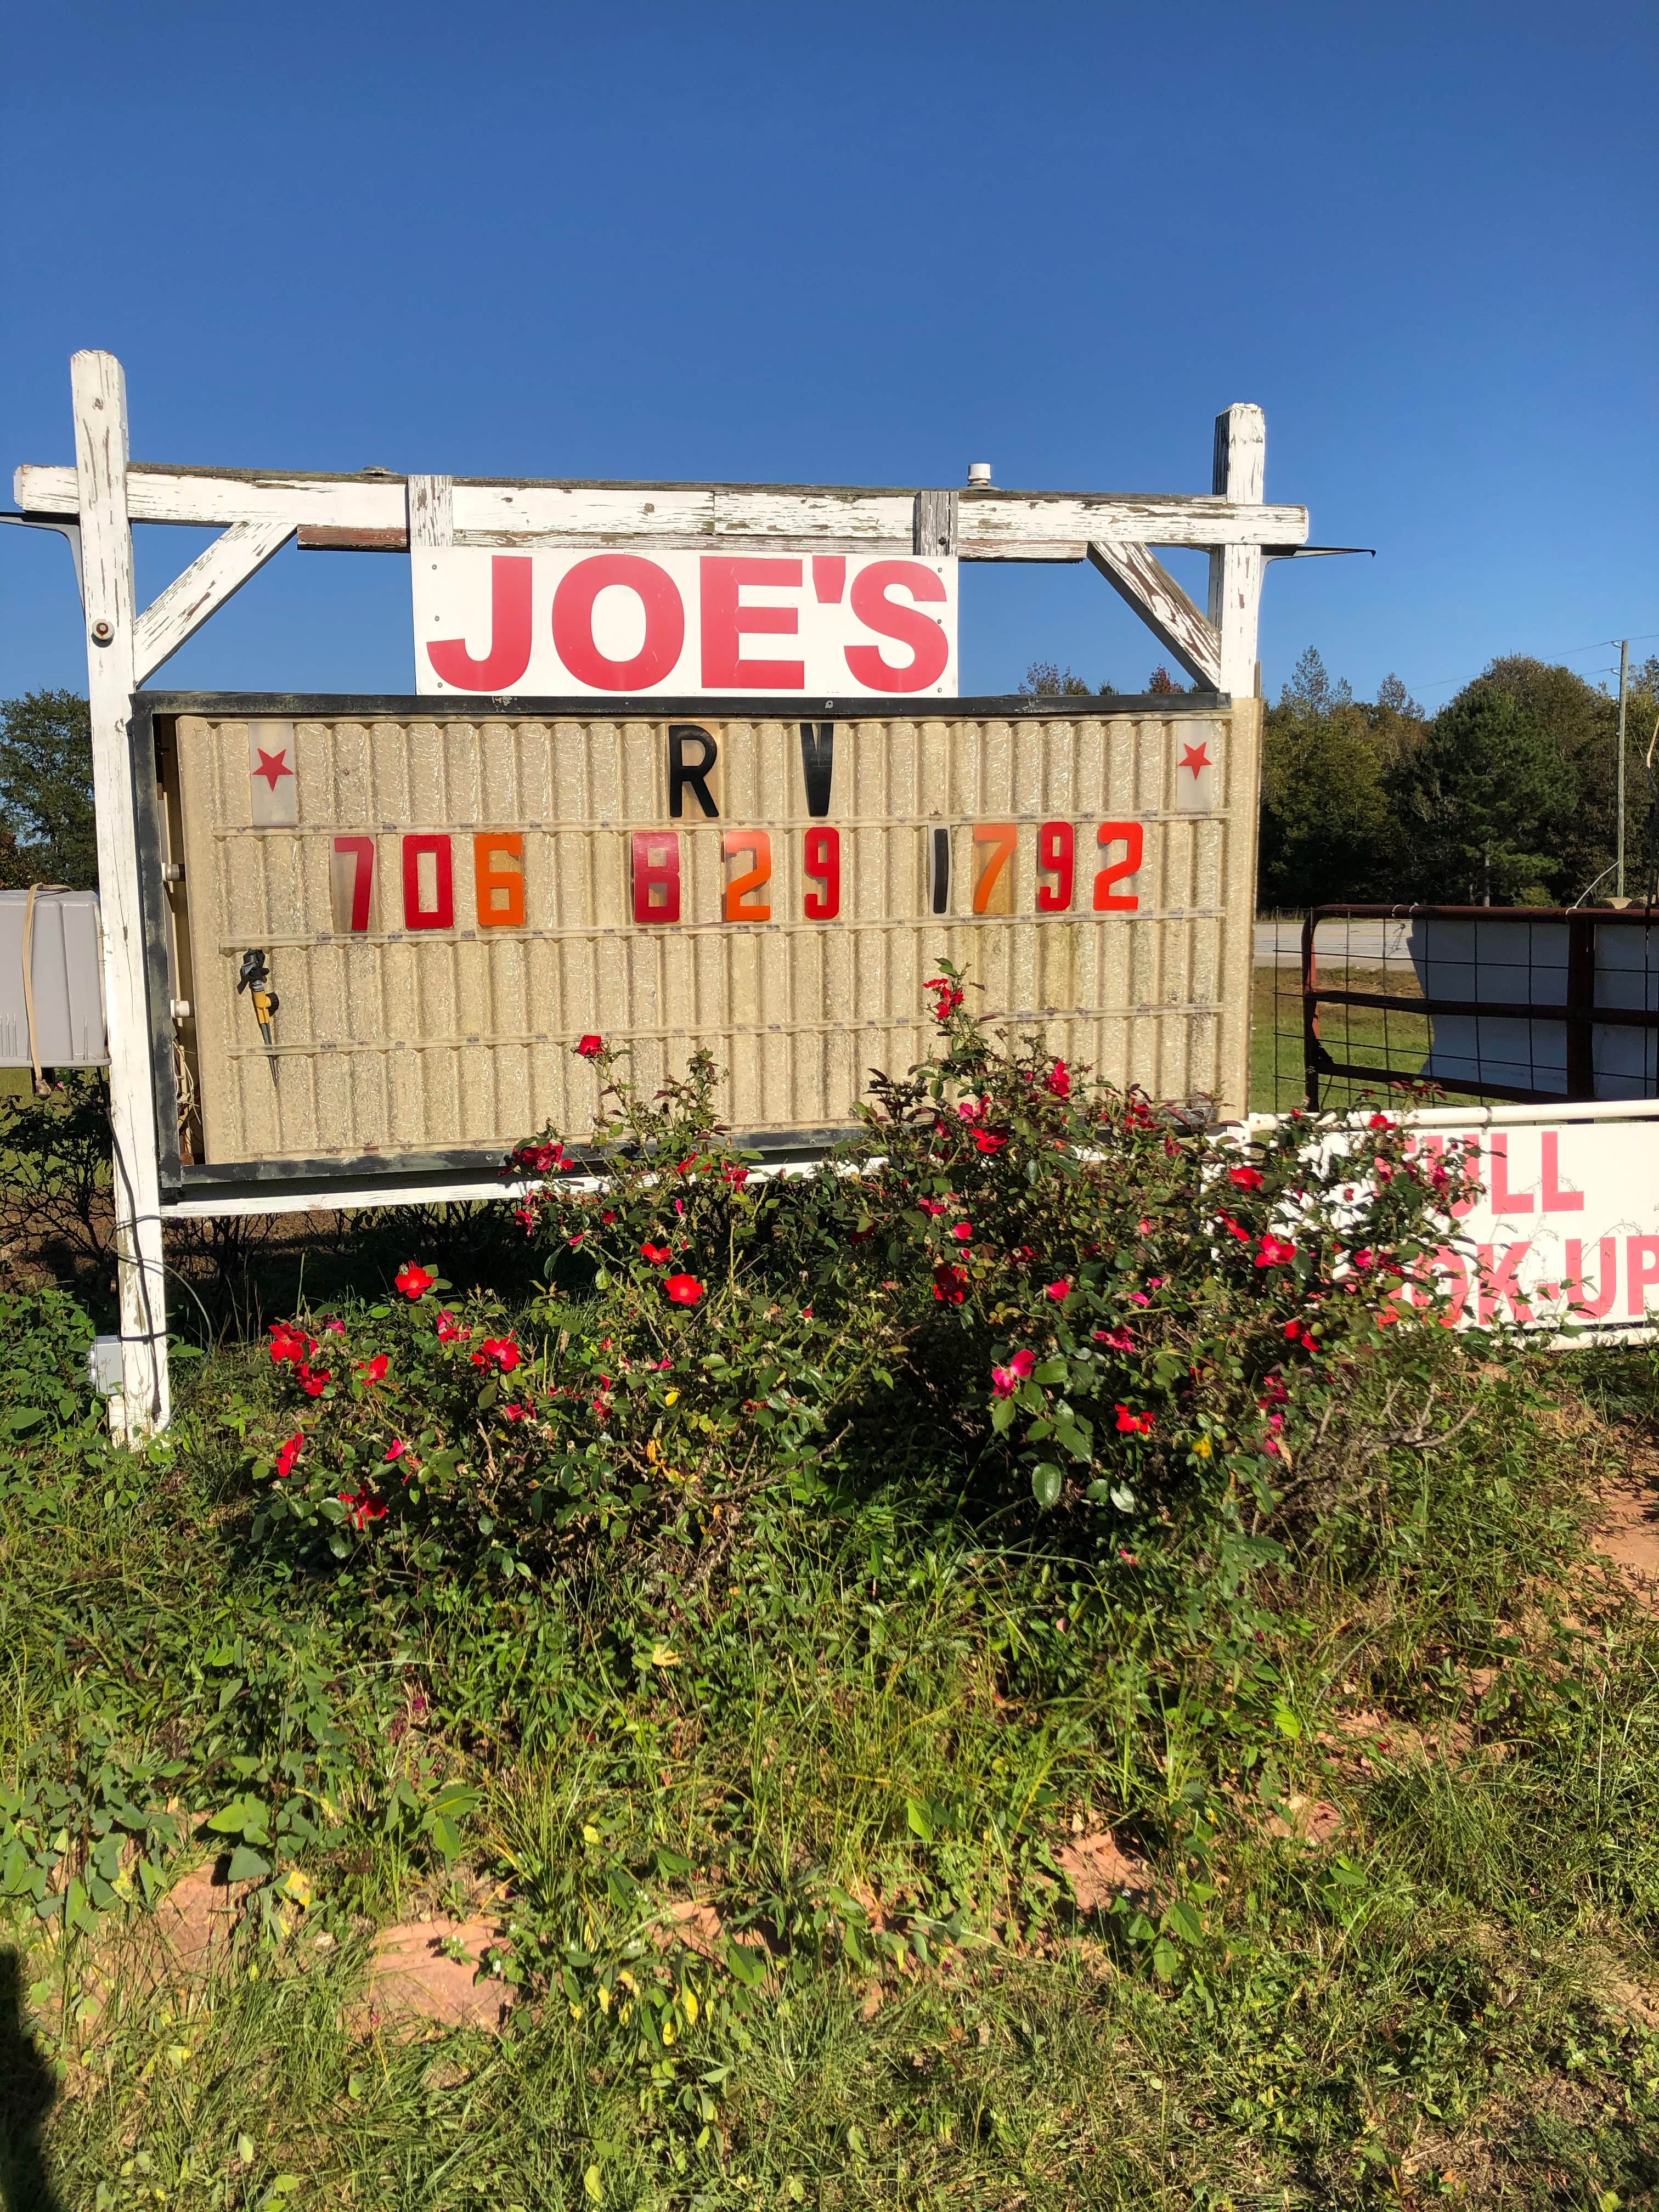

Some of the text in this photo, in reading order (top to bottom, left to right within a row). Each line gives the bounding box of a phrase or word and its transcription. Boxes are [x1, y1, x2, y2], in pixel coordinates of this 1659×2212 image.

[426, 553, 949, 693] JOE'S
[335, 821, 1143, 930] 706 829 1792
[1373, 1131, 1584, 1219] ULL
